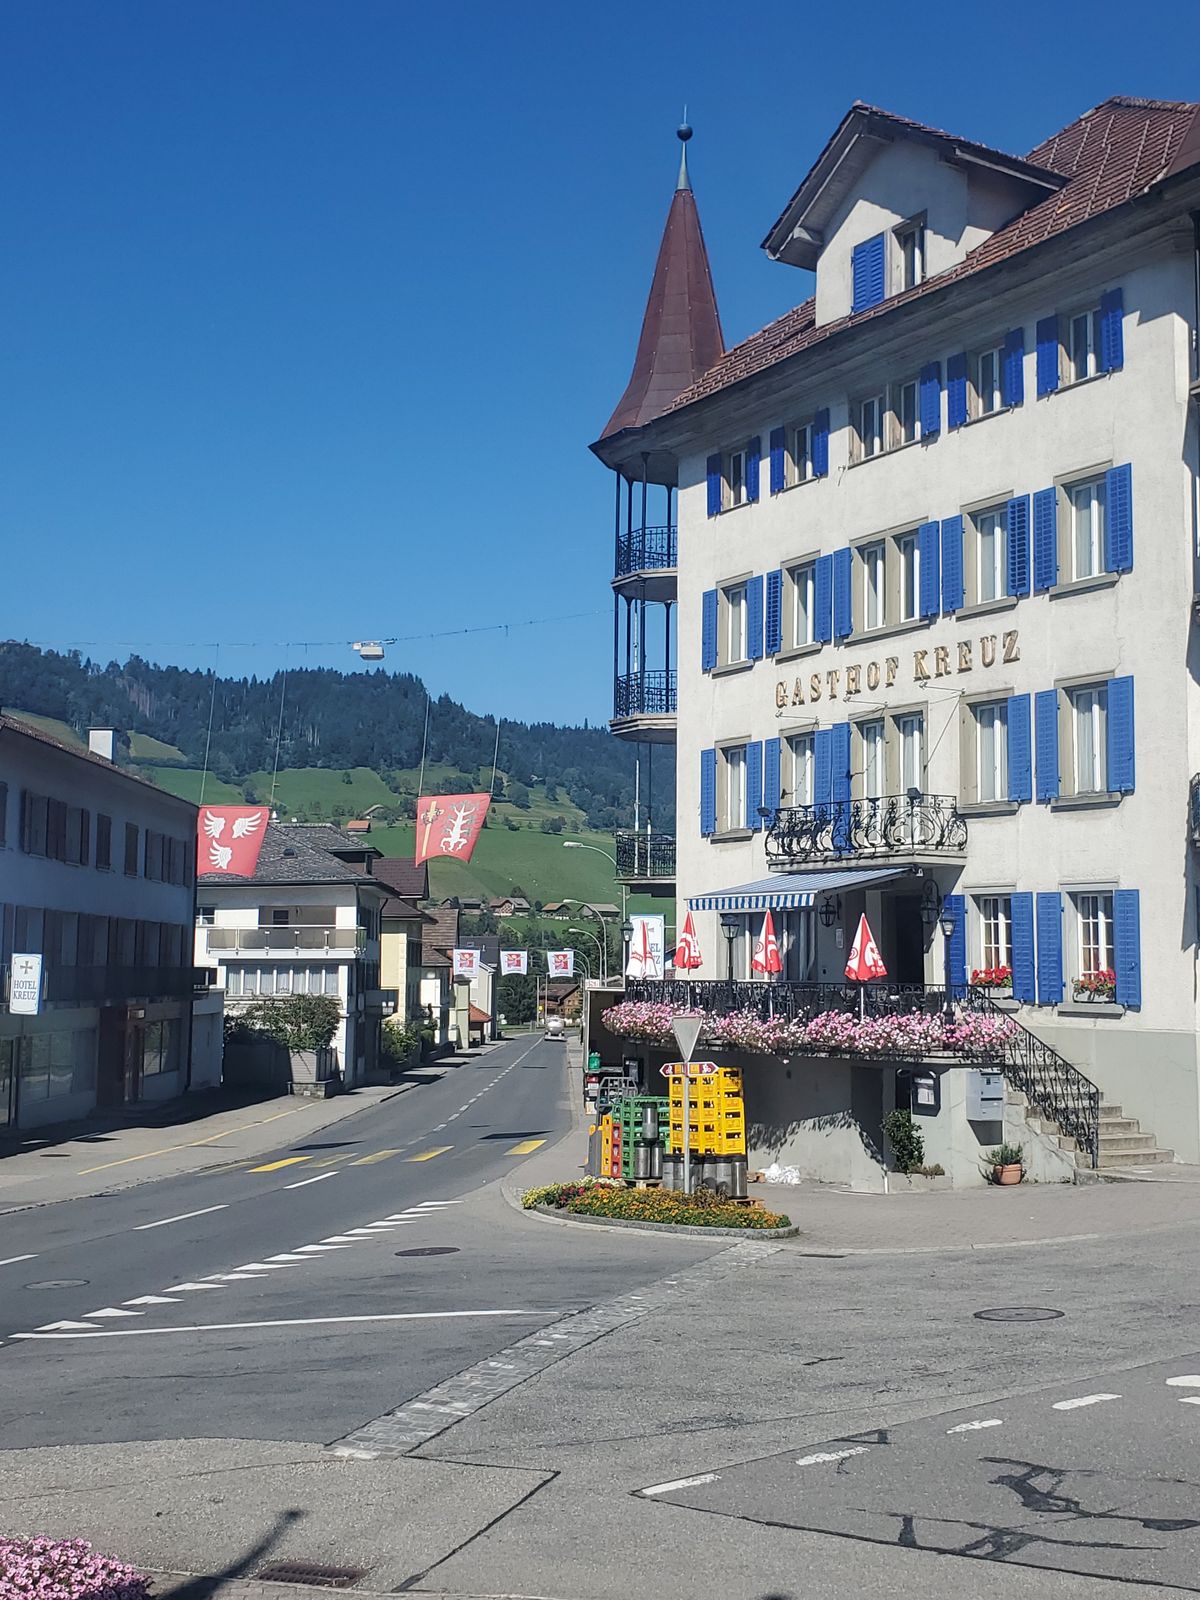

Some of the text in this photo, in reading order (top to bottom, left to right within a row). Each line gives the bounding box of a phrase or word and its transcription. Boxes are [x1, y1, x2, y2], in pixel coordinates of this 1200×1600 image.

[775, 629, 1020, 709] GASTHOF KREUZ
[13, 980, 37, 990] HOTEL
[13, 990, 37, 1000] KREUZ
